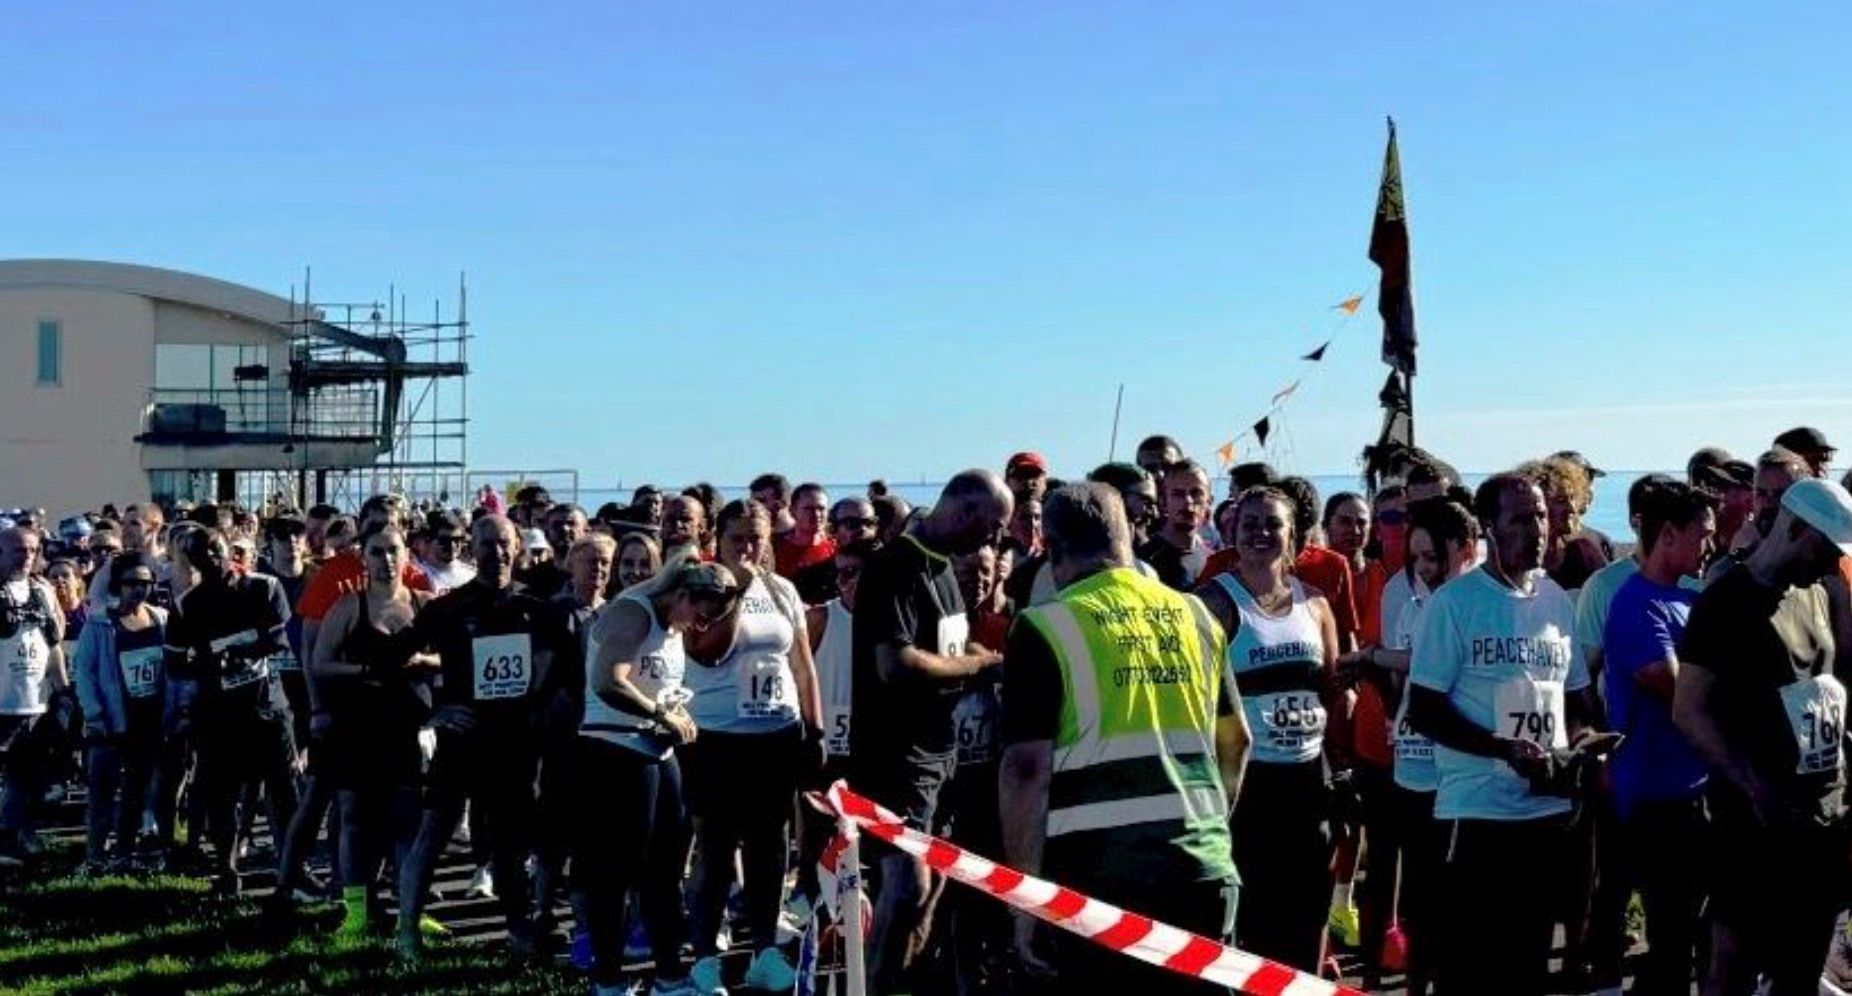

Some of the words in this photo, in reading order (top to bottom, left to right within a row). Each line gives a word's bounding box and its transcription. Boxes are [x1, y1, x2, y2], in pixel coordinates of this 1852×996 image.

[483, 654, 523, 681] 633
[833, 712, 850, 739] 5
[1509, 711, 1555, 749] 799
